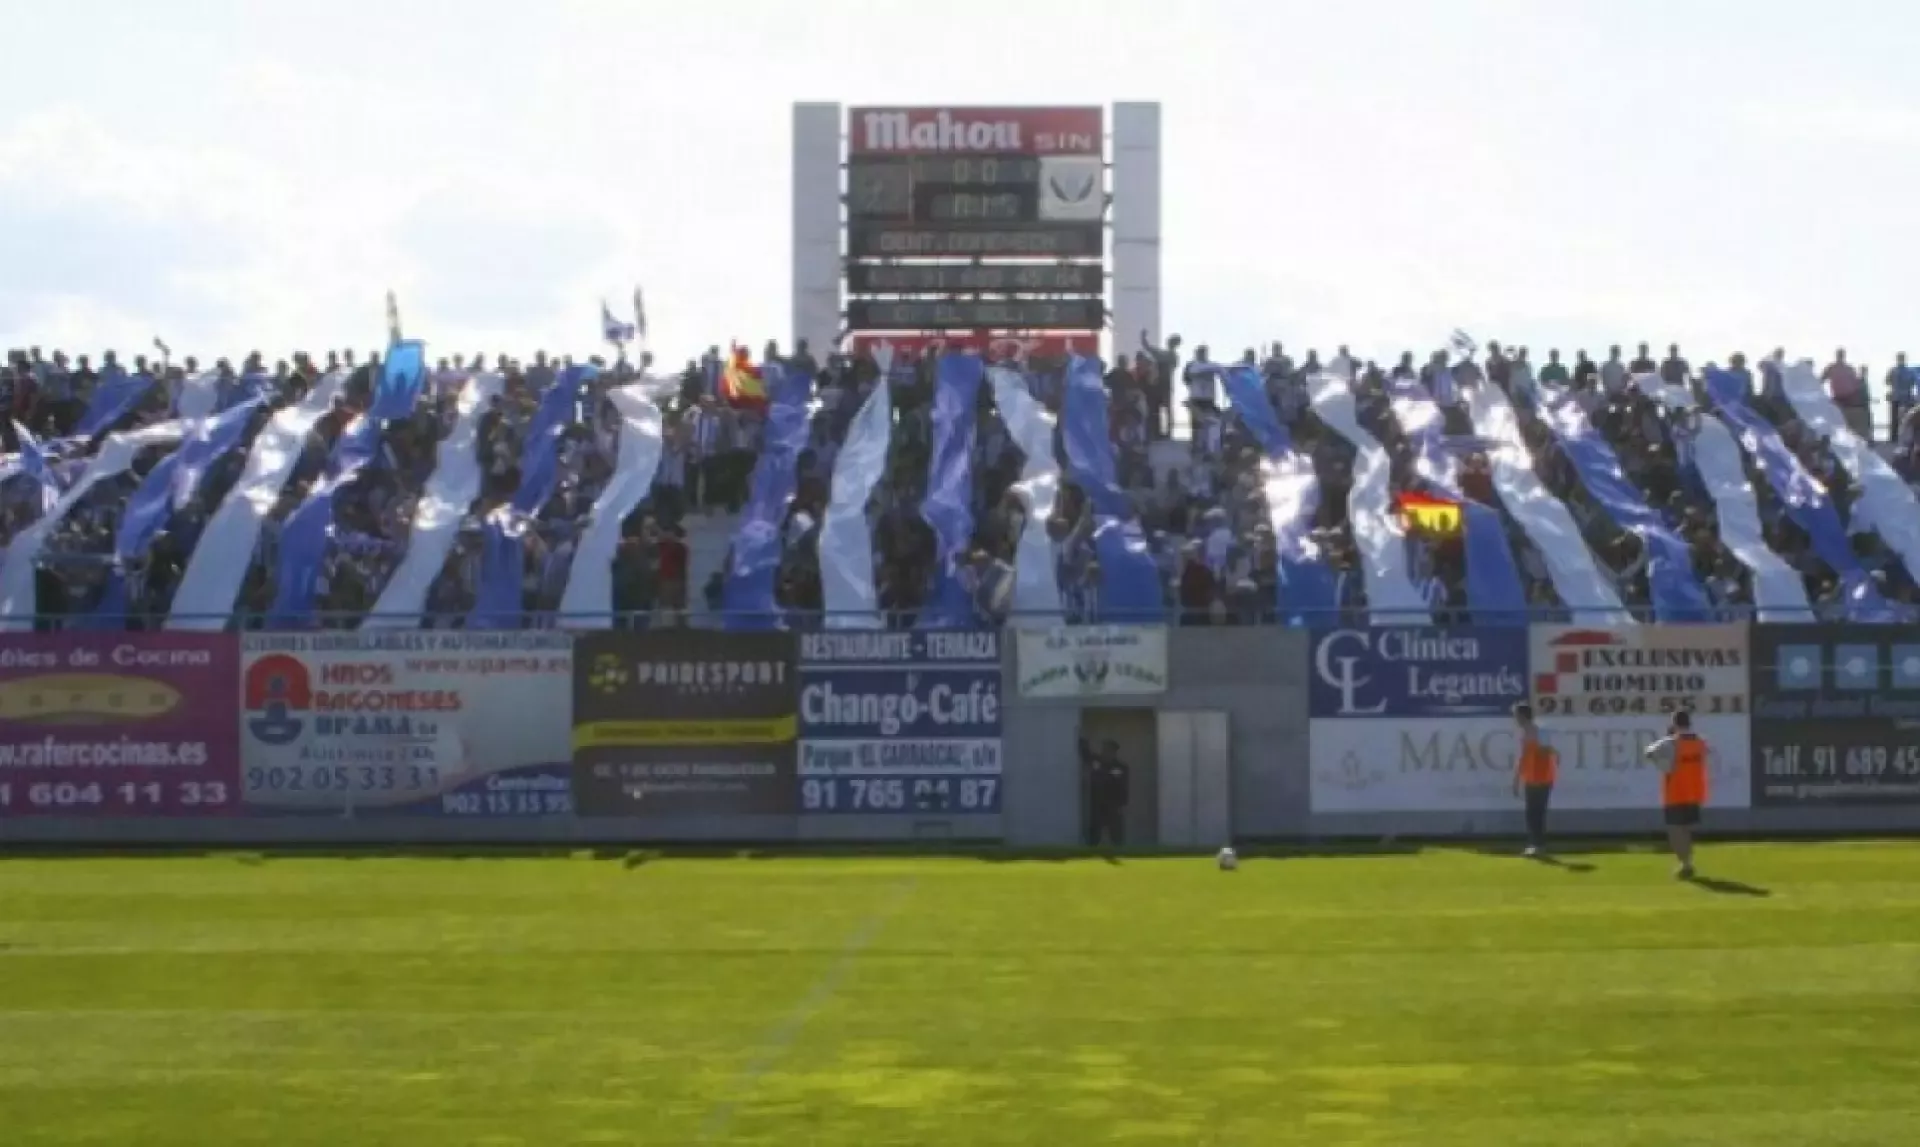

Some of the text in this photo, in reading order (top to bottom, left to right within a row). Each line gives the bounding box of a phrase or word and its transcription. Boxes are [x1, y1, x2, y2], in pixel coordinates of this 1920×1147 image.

[865, 110, 1092, 150] Mahou SIN
[68, 648, 99, 666] de
[111, 644, 211, 666] Cocina
[801, 632, 912, 660] RESTAURANTE
[926, 632, 996, 659] TERRAZA
[1377, 629, 1480, 662] Clínica
[1583, 649, 1742, 667] EXCLUSIVAS
[1407, 665, 1524, 705] Leganés
[1536, 696, 1573, 716] 91
[1588, 696, 1646, 716] 694
[1709, 696, 1744, 715] 11
[1398, 729, 1659, 774] MAGTER
[248, 766, 306, 791] 902
[312, 766, 349, 790] 05
[360, 766, 397, 790] 33
[28, 782, 104, 804] 604
[116, 782, 162, 804] 11
[177, 782, 229, 804] 33
[802, 779, 837, 809] 91
[849, 779, 905, 809] 765
[960, 779, 996, 808] 87
